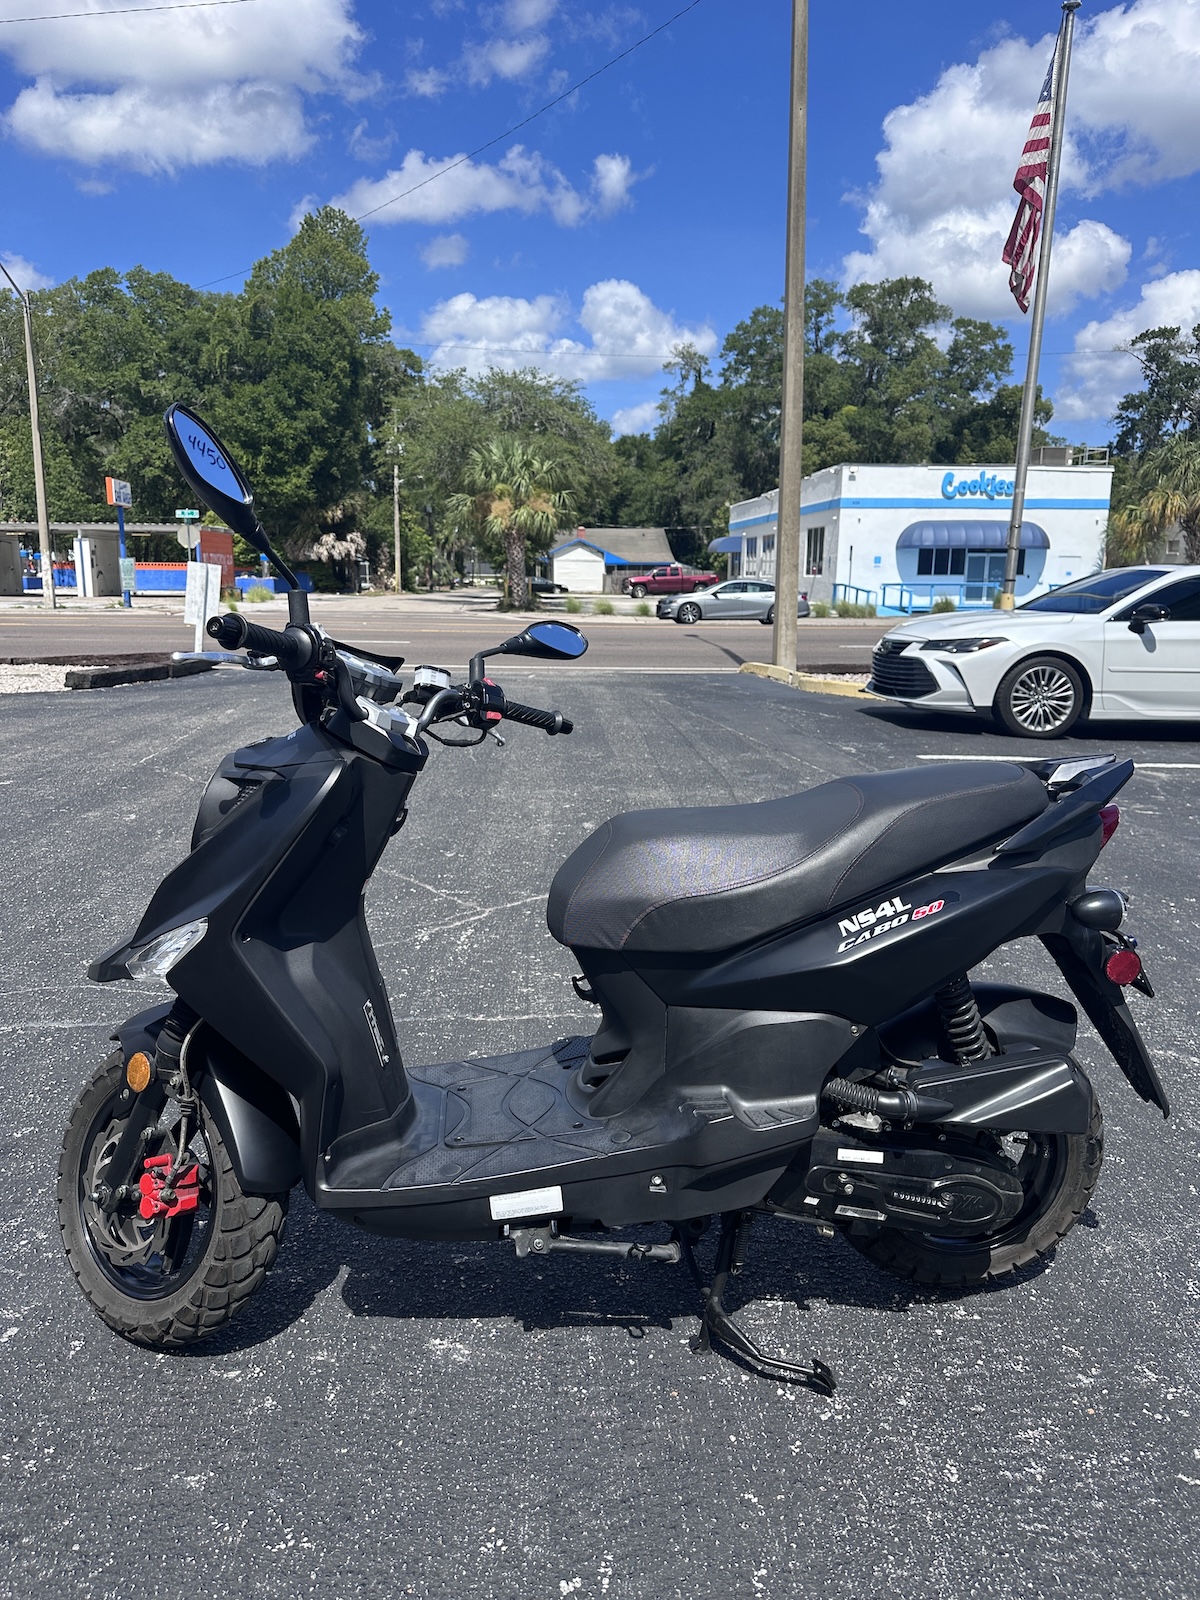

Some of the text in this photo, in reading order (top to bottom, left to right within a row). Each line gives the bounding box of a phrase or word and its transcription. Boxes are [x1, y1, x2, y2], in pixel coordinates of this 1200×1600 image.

[188, 434, 226, 470] 4450
[941, 470, 1016, 500] Cookies
[837, 896, 912, 938] NS4L
[837, 899, 945, 953] CABO 50
